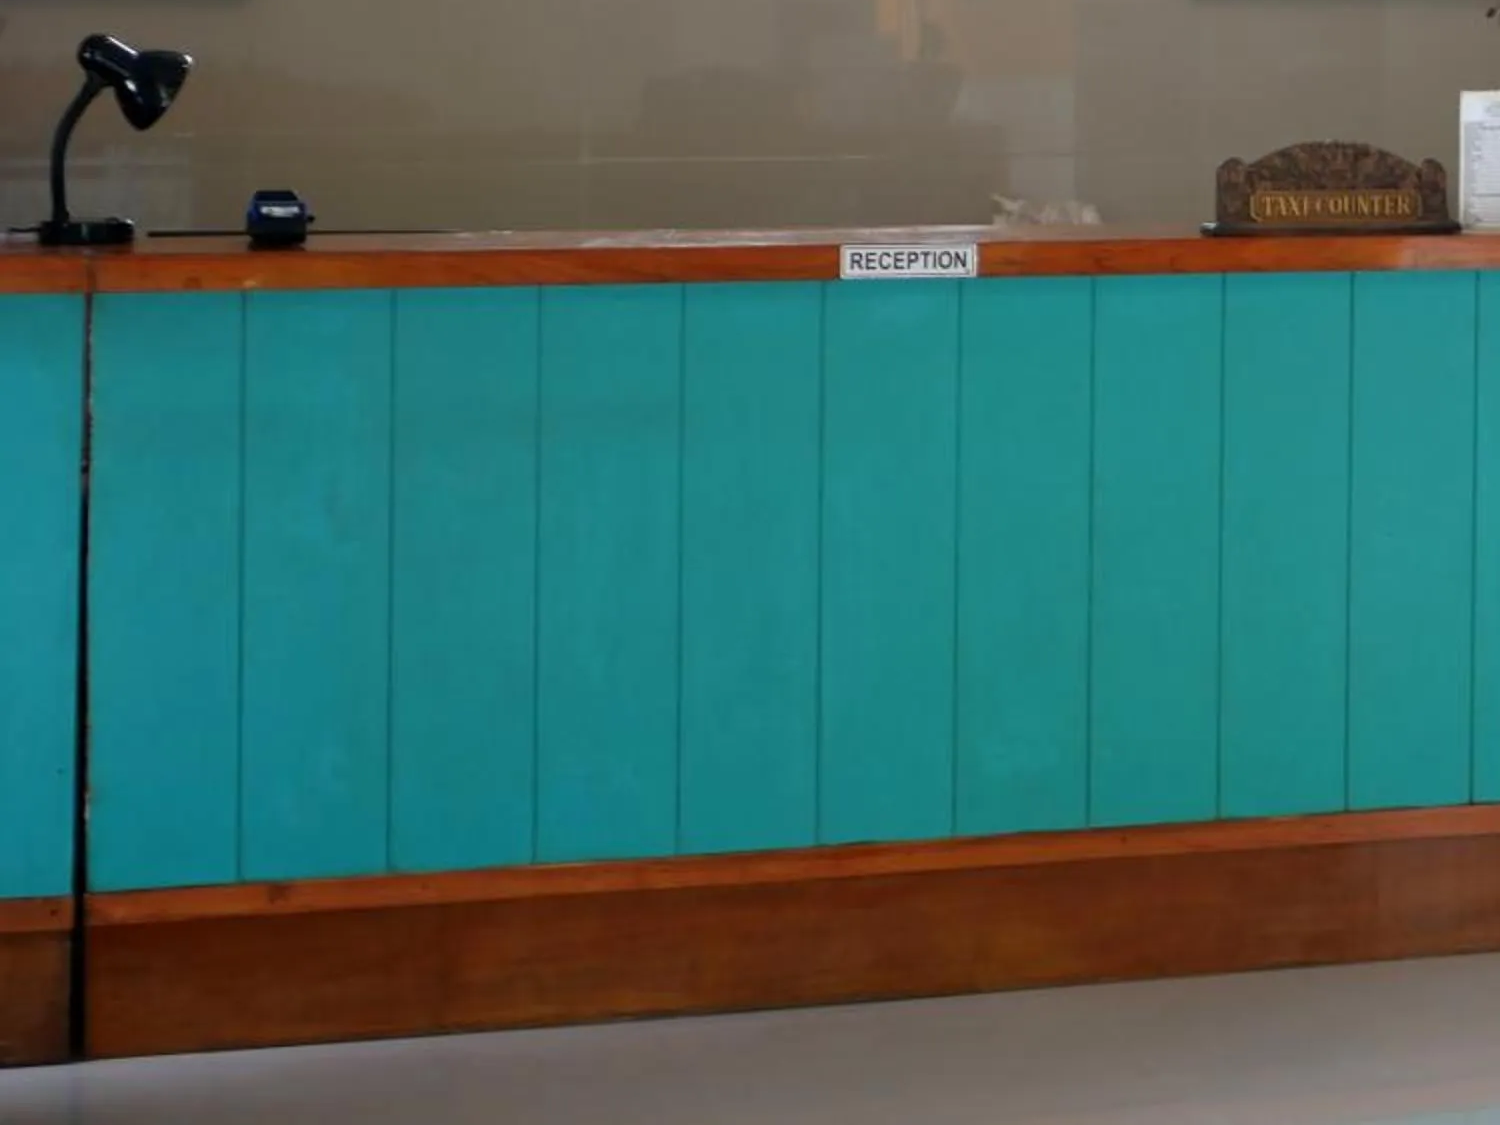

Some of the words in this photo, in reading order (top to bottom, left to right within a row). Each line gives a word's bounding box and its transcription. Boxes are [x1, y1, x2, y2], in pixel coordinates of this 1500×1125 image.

[1260, 195, 1306, 218] TAXI
[1313, 193, 1412, 216] COUNTER
[849, 250, 968, 271] RECEPTION
